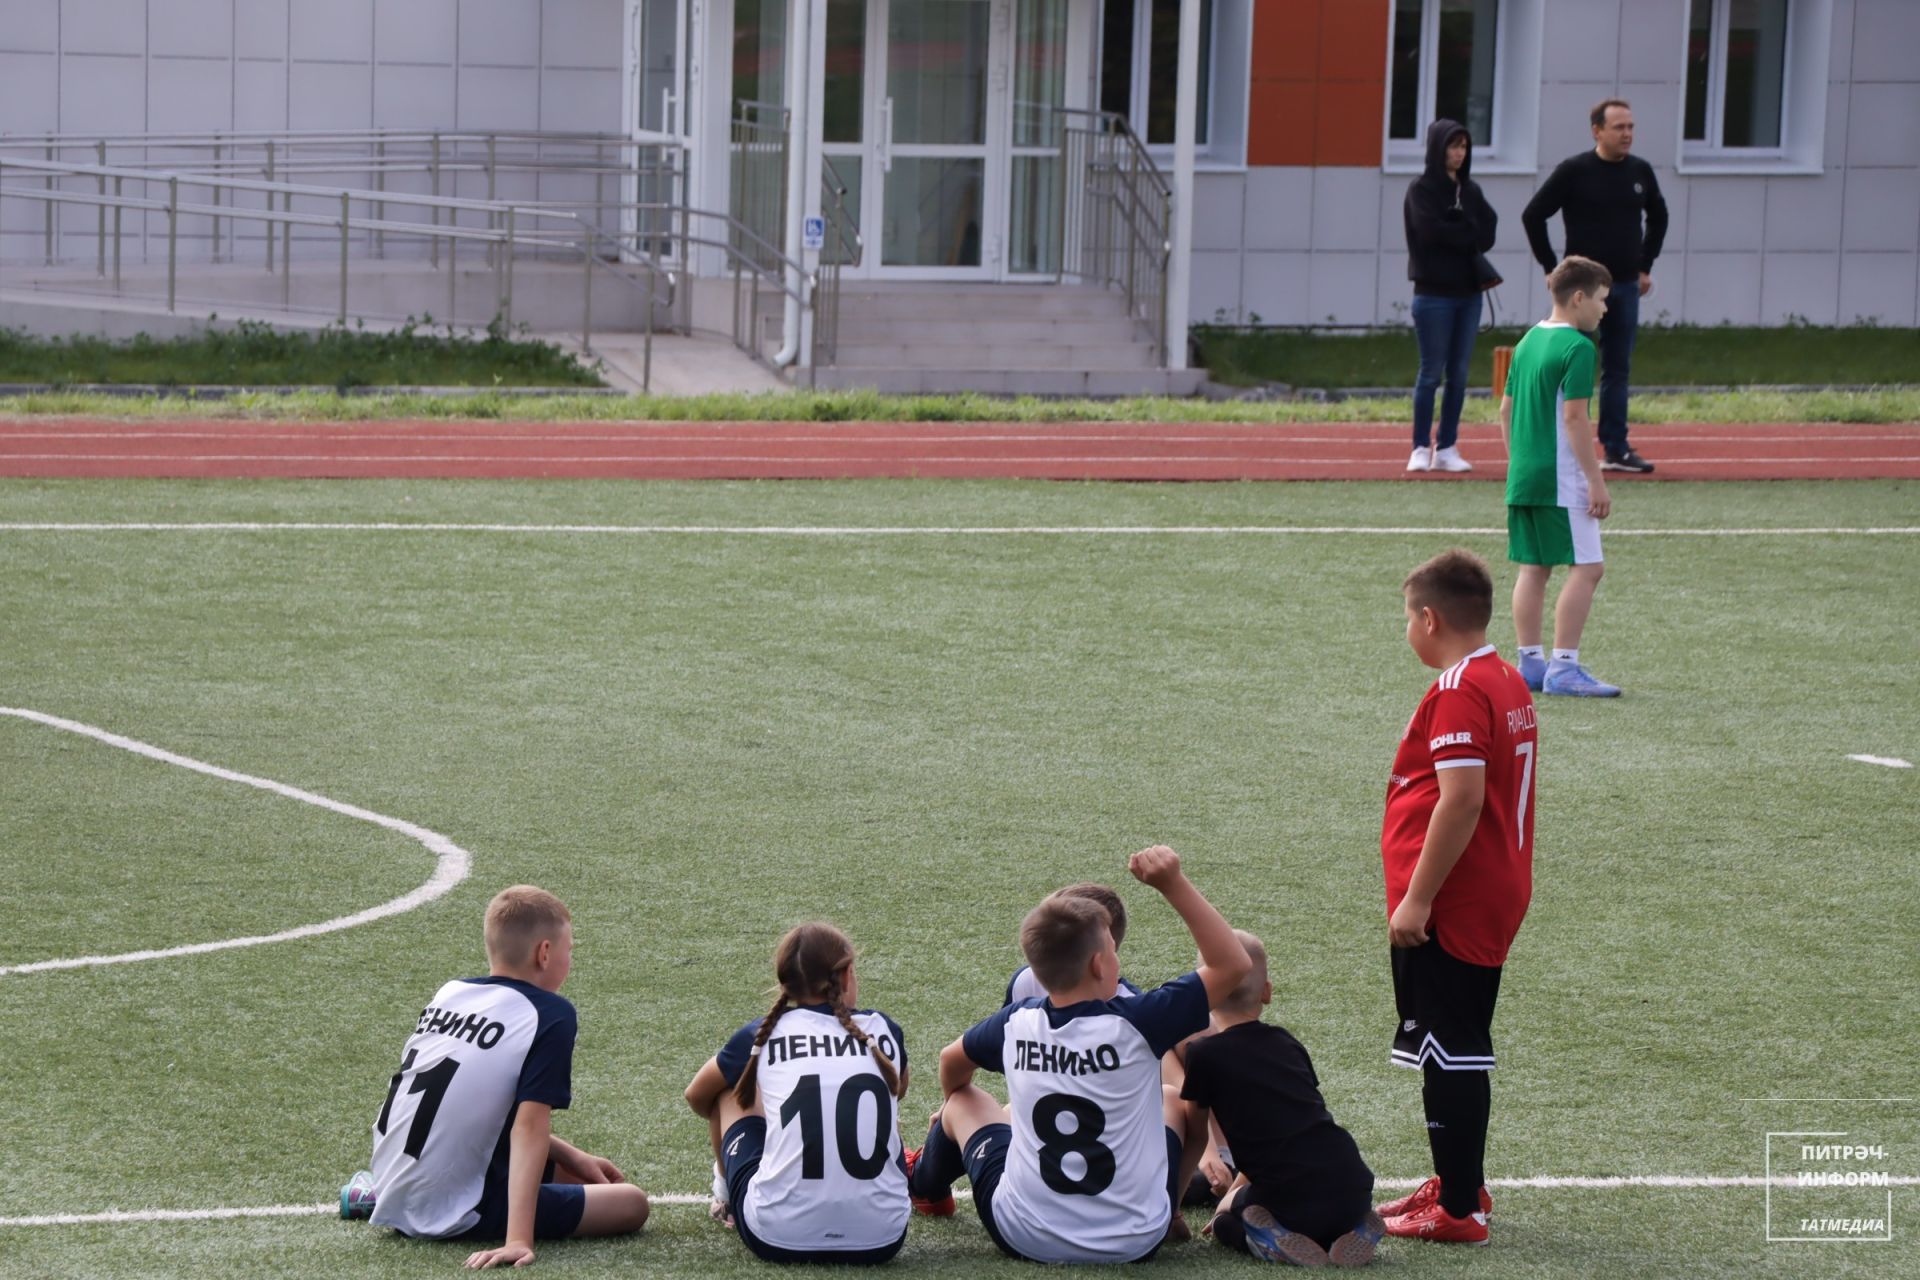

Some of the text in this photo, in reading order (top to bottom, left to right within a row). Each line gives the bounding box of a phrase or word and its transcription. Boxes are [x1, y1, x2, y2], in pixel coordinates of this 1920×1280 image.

[1515, 741, 1534, 852] 7
[377, 1048, 461, 1161] 11
[1014, 1039, 1120, 1076] ЛЕНИНО
[779, 1072, 892, 1181] 10
[1031, 1092, 1117, 1197] 8
